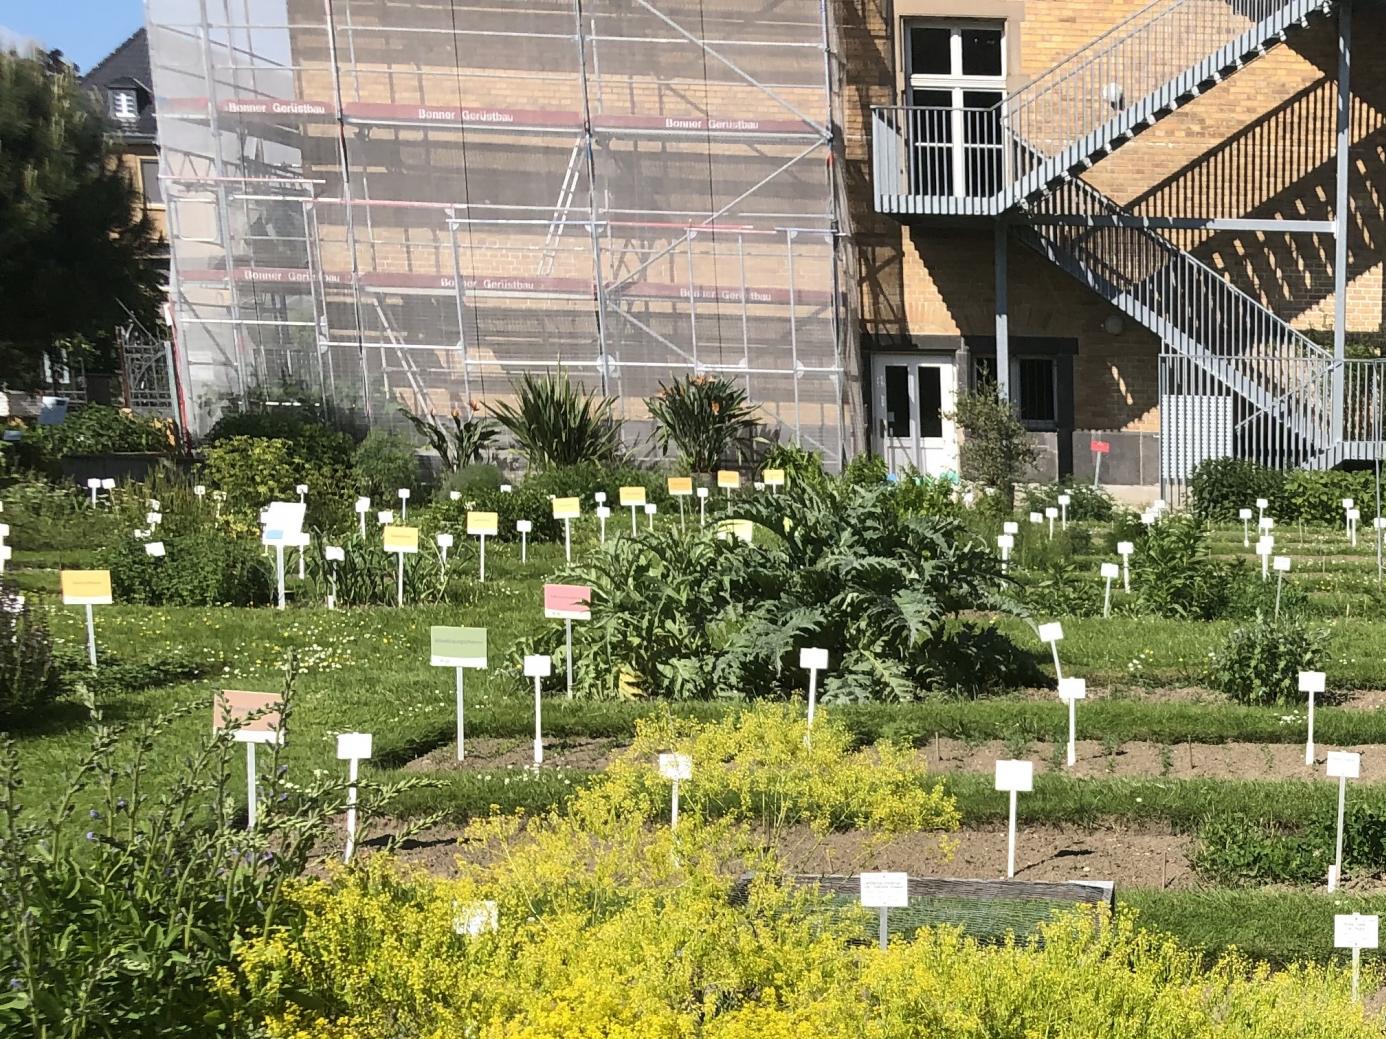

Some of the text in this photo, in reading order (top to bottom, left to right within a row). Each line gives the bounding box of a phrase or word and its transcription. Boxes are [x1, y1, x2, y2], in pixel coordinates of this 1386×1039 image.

[228, 102, 325, 114] Bonner Gerüstbau
[418, 108, 514, 121] Bonner Gerüstbau
[665, 118, 702, 128] Bonner
[244, 270, 282, 281] Bonner
[440, 278, 535, 289] Boner Gerüstbau
[721, 289, 772, 301] Gertbau
